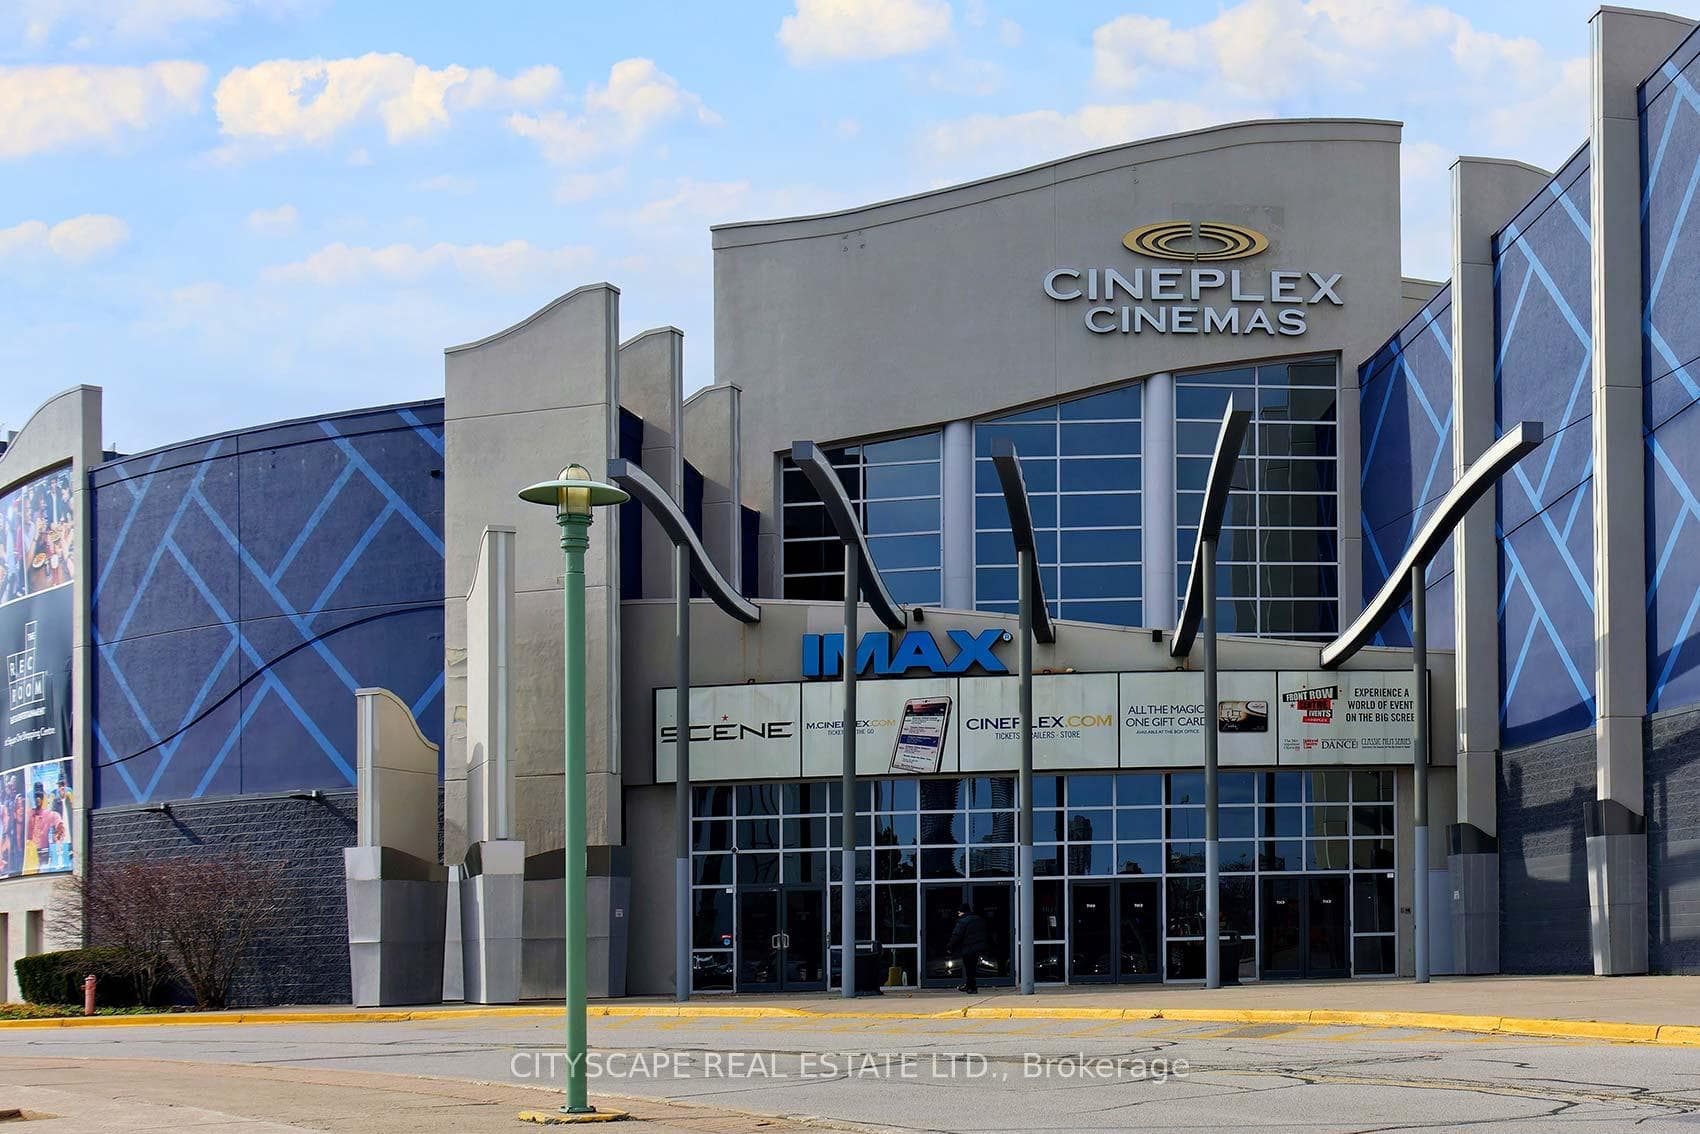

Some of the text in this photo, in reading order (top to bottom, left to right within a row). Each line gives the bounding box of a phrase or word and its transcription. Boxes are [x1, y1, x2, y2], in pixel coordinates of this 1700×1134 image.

[1043, 267, 1344, 306] CINEPLEX
[1084, 305, 1307, 337] CINEMAS
[10, 657, 33, 676] REC
[1286, 687, 1334, 702] FRONT ROW
[1354, 688, 1410, 698] EXPERIENCE A
[1128, 705, 1147, 715] ALL
[1147, 704, 1169, 715] THE
[1347, 700, 1414, 710] WORLD OF EVENT
[1125, 717, 1150, 728] ONE
[1151, 717, 1175, 727] GIFT
[1345, 712, 1415, 722] ON THE BIG SCREE
[660, 722, 793, 743] SCENE
[995, 731, 1021, 740] TICKETS
[1060, 730, 1081, 739] STORE
[1321, 740, 1358, 750] DANCE
